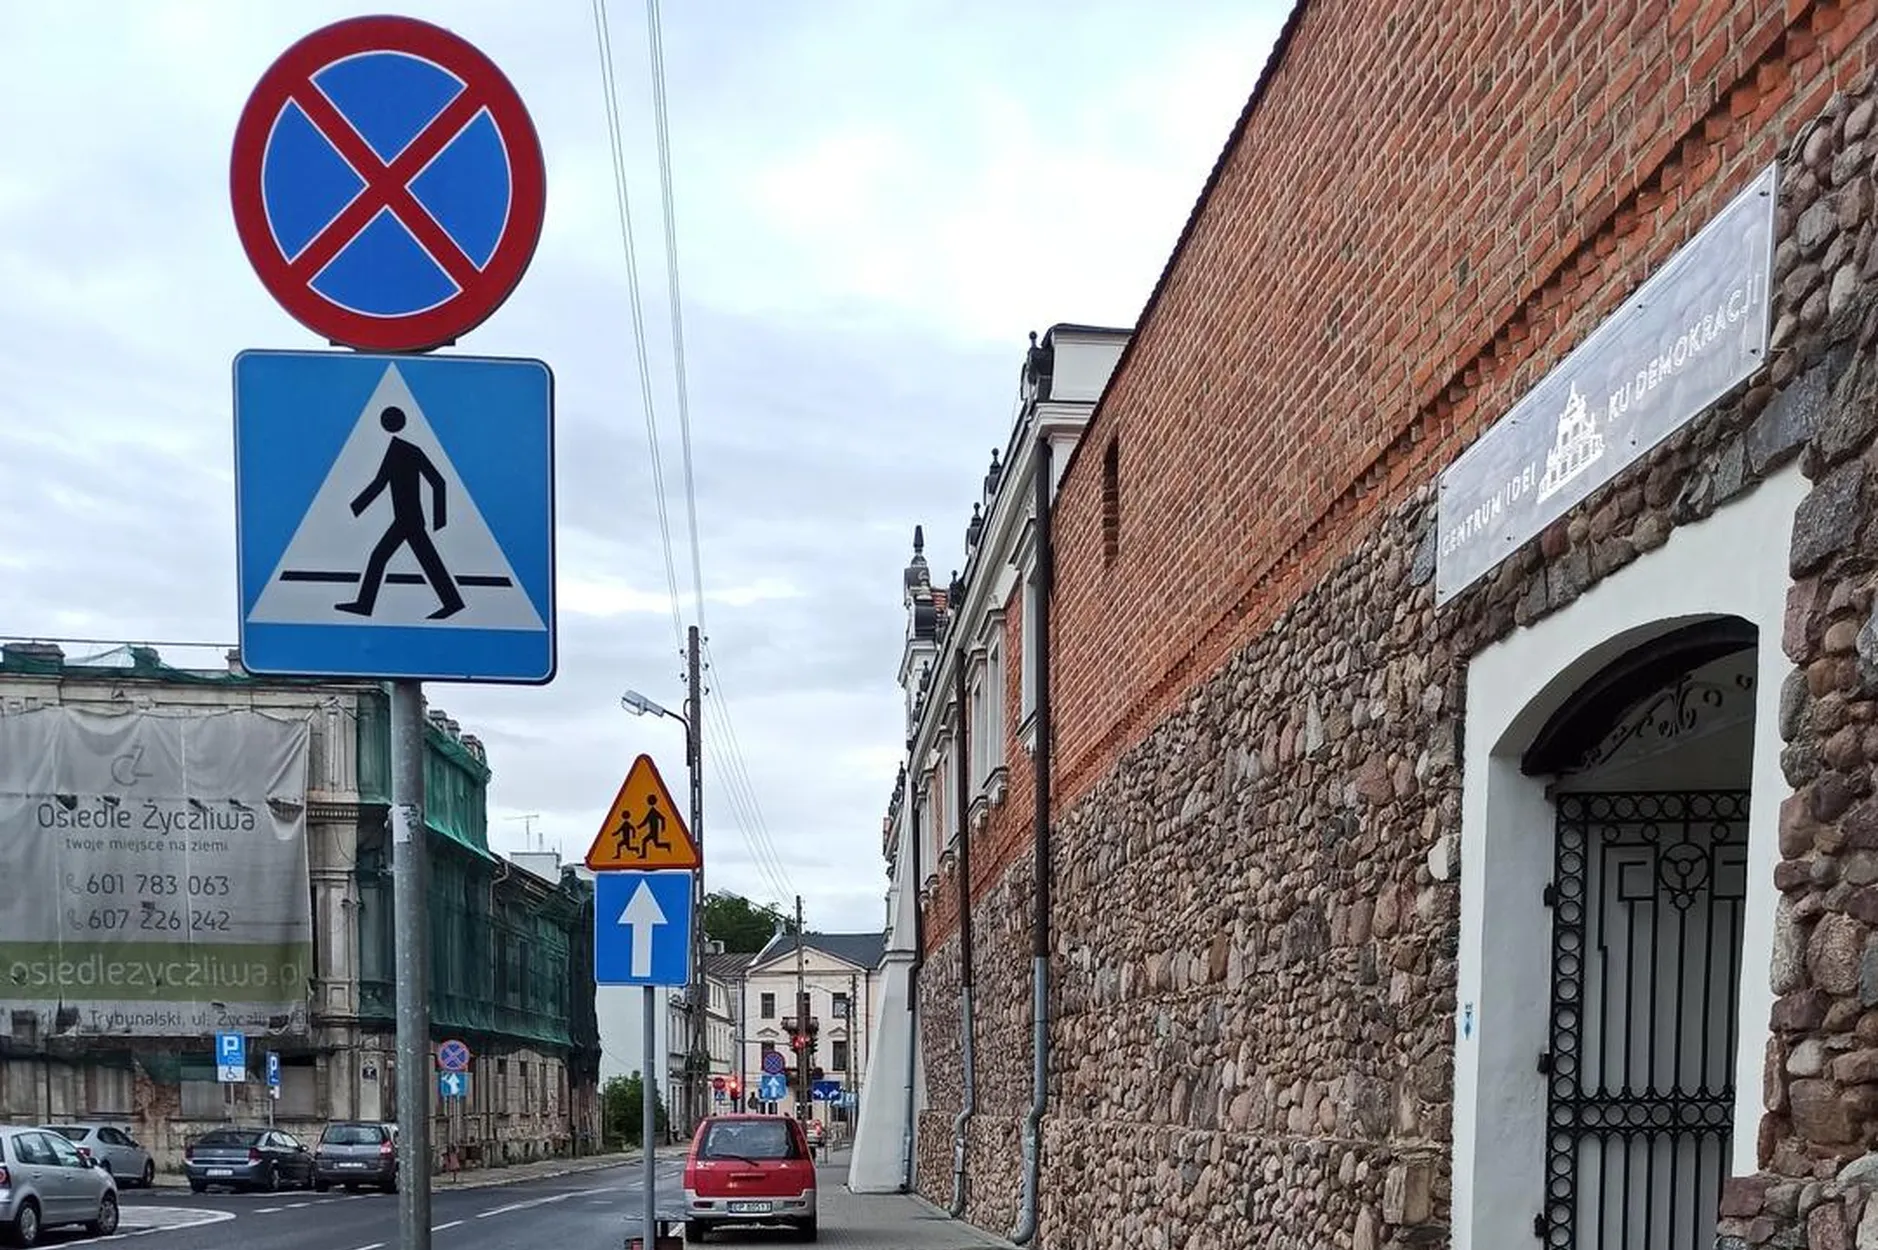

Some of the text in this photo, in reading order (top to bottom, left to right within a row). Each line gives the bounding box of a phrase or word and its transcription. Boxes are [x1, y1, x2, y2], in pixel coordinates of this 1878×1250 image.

[1442, 273, 1763, 557] CENTRUM IDEI KU DEMOKRACJI
[37, 798, 256, 836] Osiedle Życzliwa
[65, 838, 230, 853] twoje miejsce na ziemi
[86, 874, 230, 896] 601 783 063
[88, 909, 231, 931] 607 226 242
[10, 953, 303, 995] osiedlezyczliwa.pl
[222, 1035, 240, 1057] P
[269, 1055, 278, 1076] P
